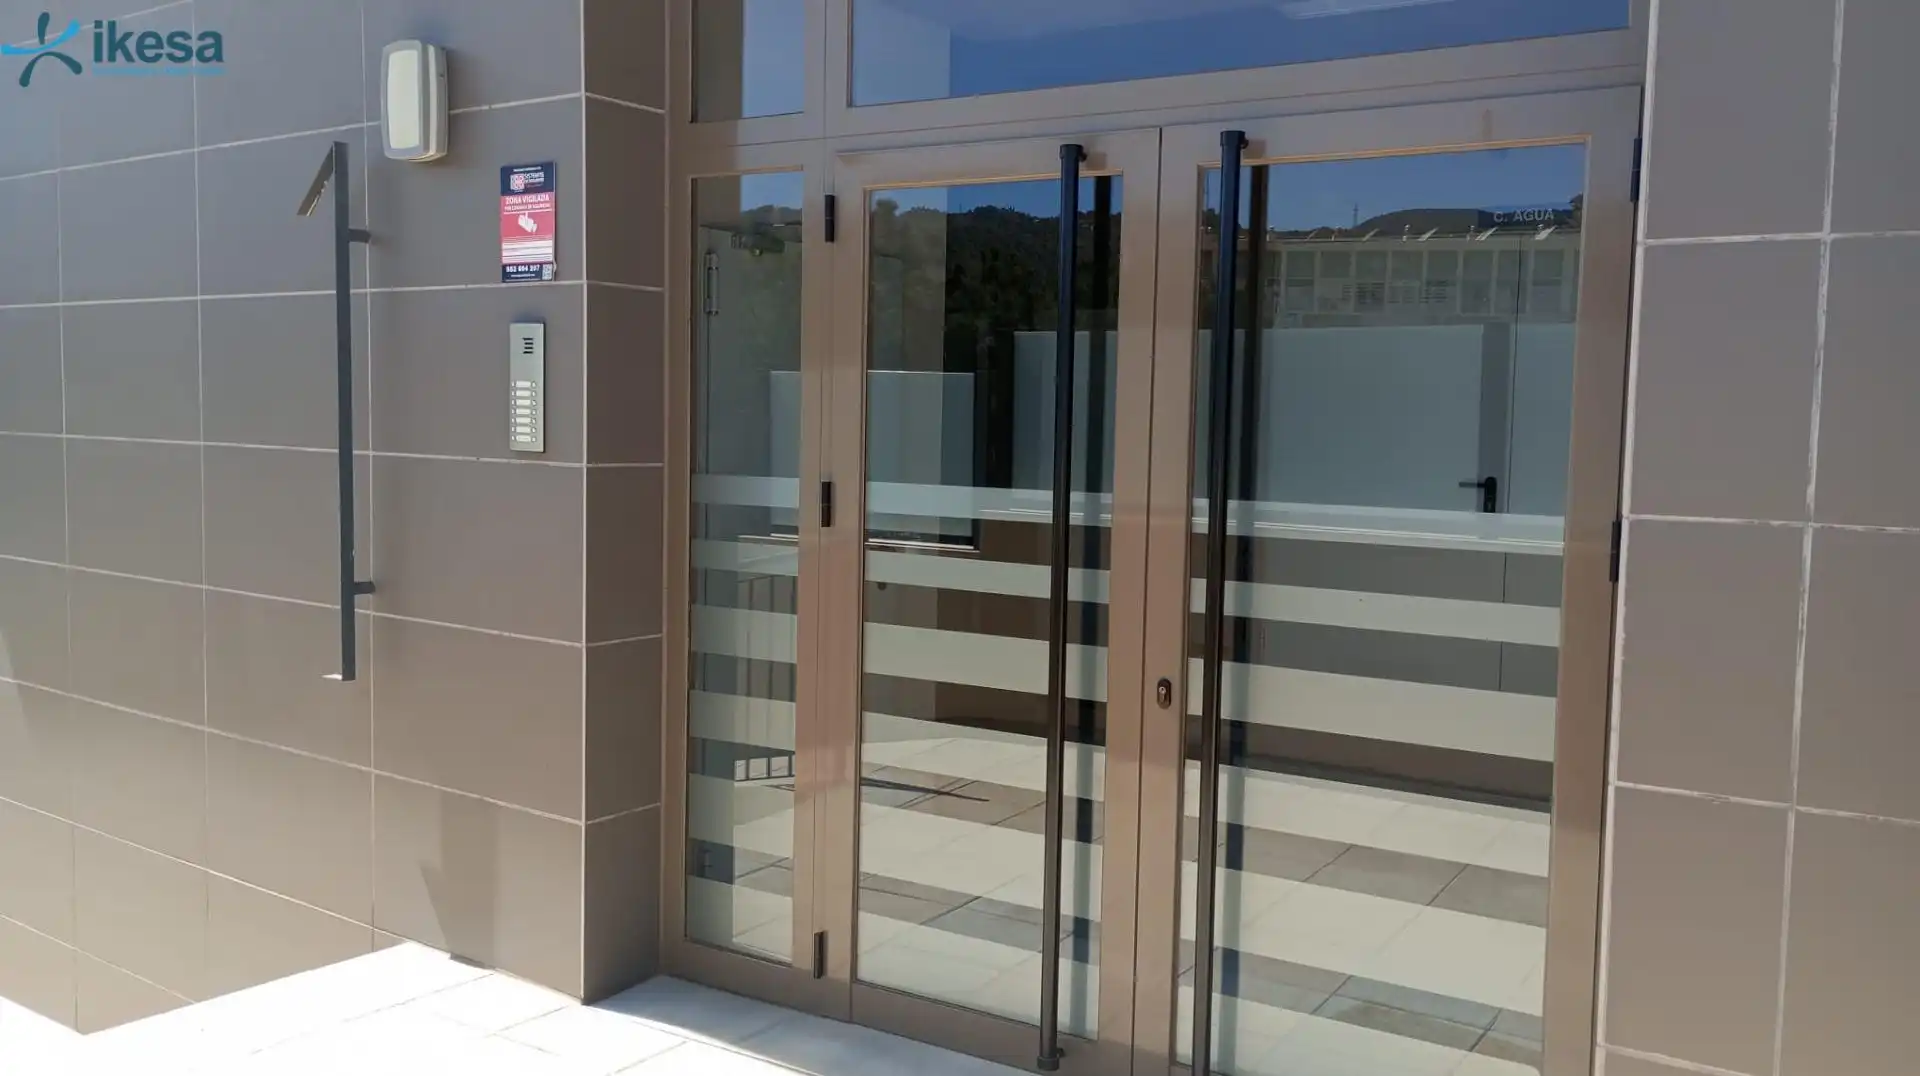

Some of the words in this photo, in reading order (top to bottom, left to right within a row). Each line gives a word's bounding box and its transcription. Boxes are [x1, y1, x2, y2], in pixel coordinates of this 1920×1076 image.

[505, 195, 522, 205] ZONA
[522, 193, 550, 203] VIGILADA
[1493, 211, 1508, 223] C.
[1513, 208, 1555, 222] AGUA
